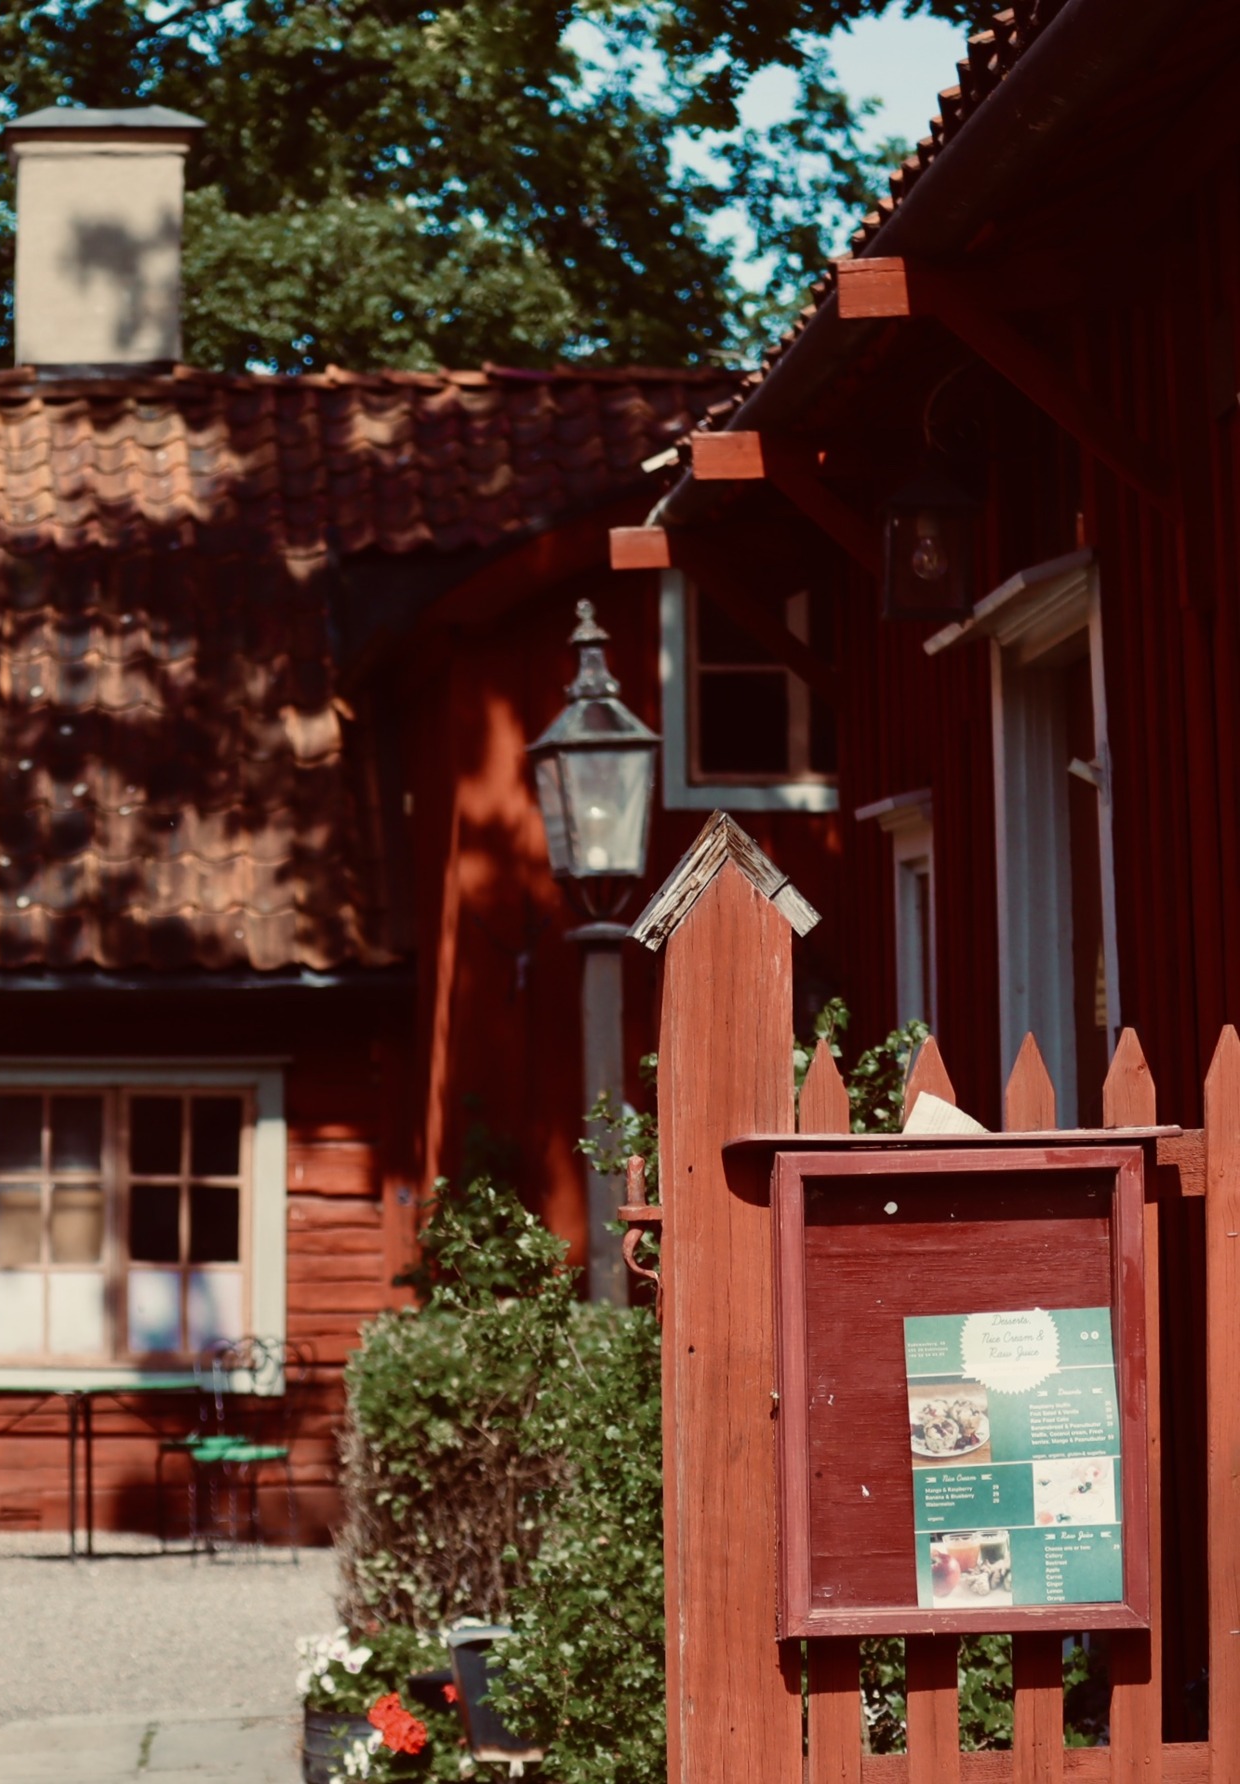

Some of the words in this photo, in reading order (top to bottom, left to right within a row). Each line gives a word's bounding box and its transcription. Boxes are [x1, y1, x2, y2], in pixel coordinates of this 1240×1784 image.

[992, 1314, 1032, 1326] Desserts,
[982, 1332, 1000, 1344] Nice
[1003, 1331, 1034, 1343] Cream
[1036, 1329, 1044, 1341] &
[989, 1347, 1012, 1358] Raw
[1016, 1346, 1039, 1361] Juice
[942, 1474, 955, 1482] Nice
[1061, 1531, 1076, 1539] Raw
[1078, 1530, 1094, 1541] Juice
